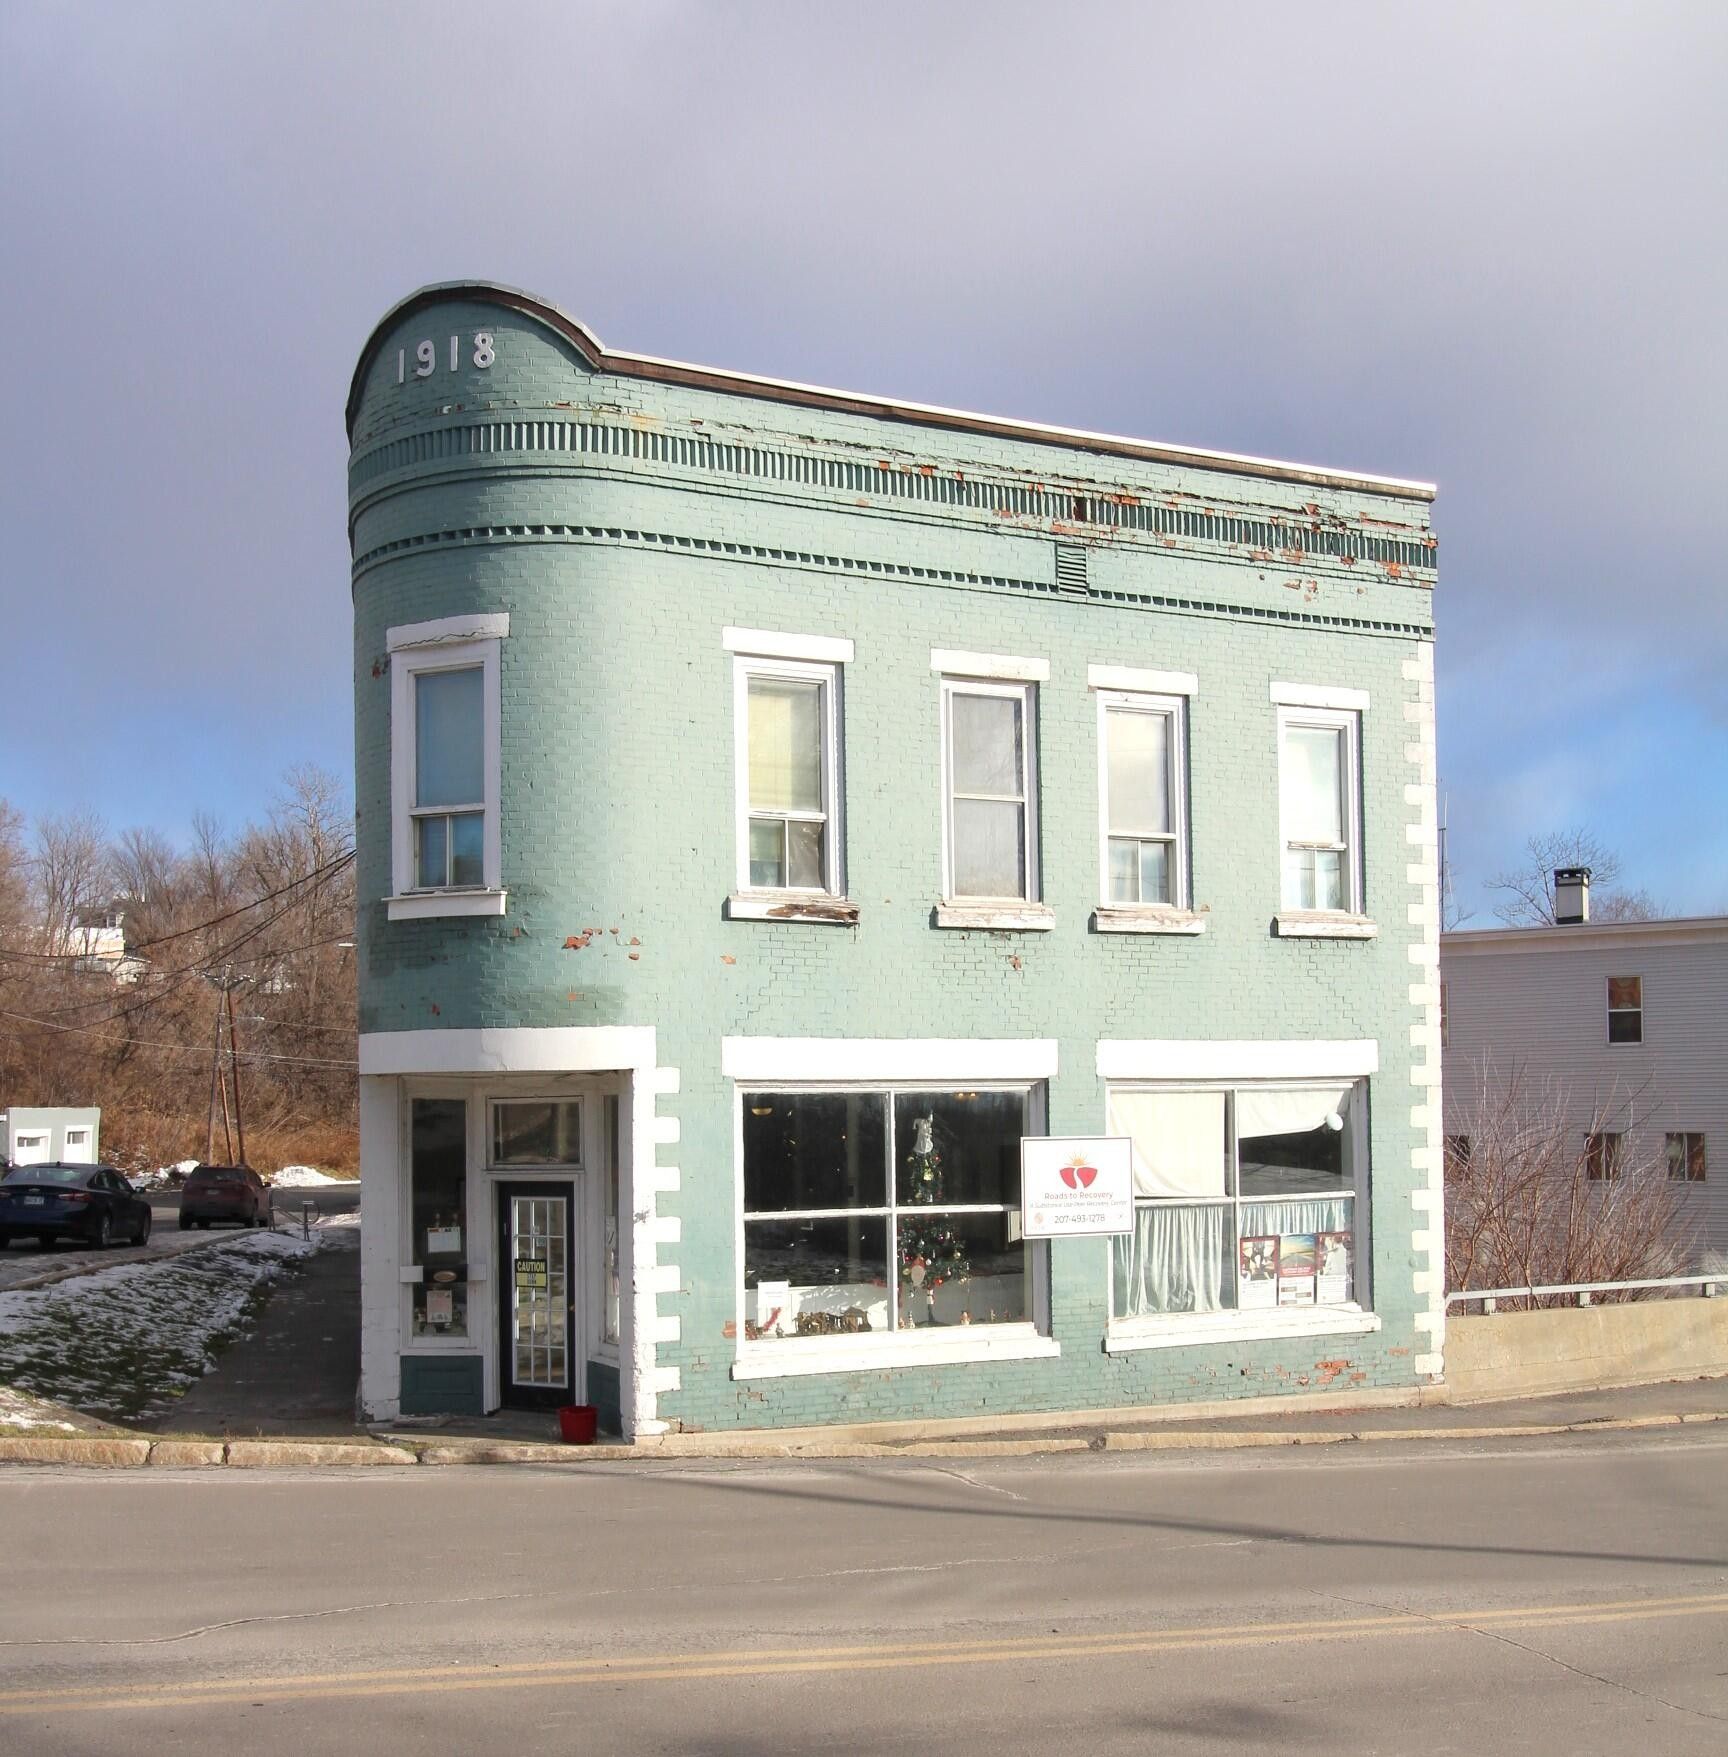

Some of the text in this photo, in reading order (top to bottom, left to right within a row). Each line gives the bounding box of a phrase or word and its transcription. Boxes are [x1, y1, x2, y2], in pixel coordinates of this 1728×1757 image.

[398, 332, 496, 384] 1918
[1044, 1192, 1067, 1200] Roads
[1079, 1191, 1113, 1200] Recovery
[517, 1261, 545, 1272] CAUTION
